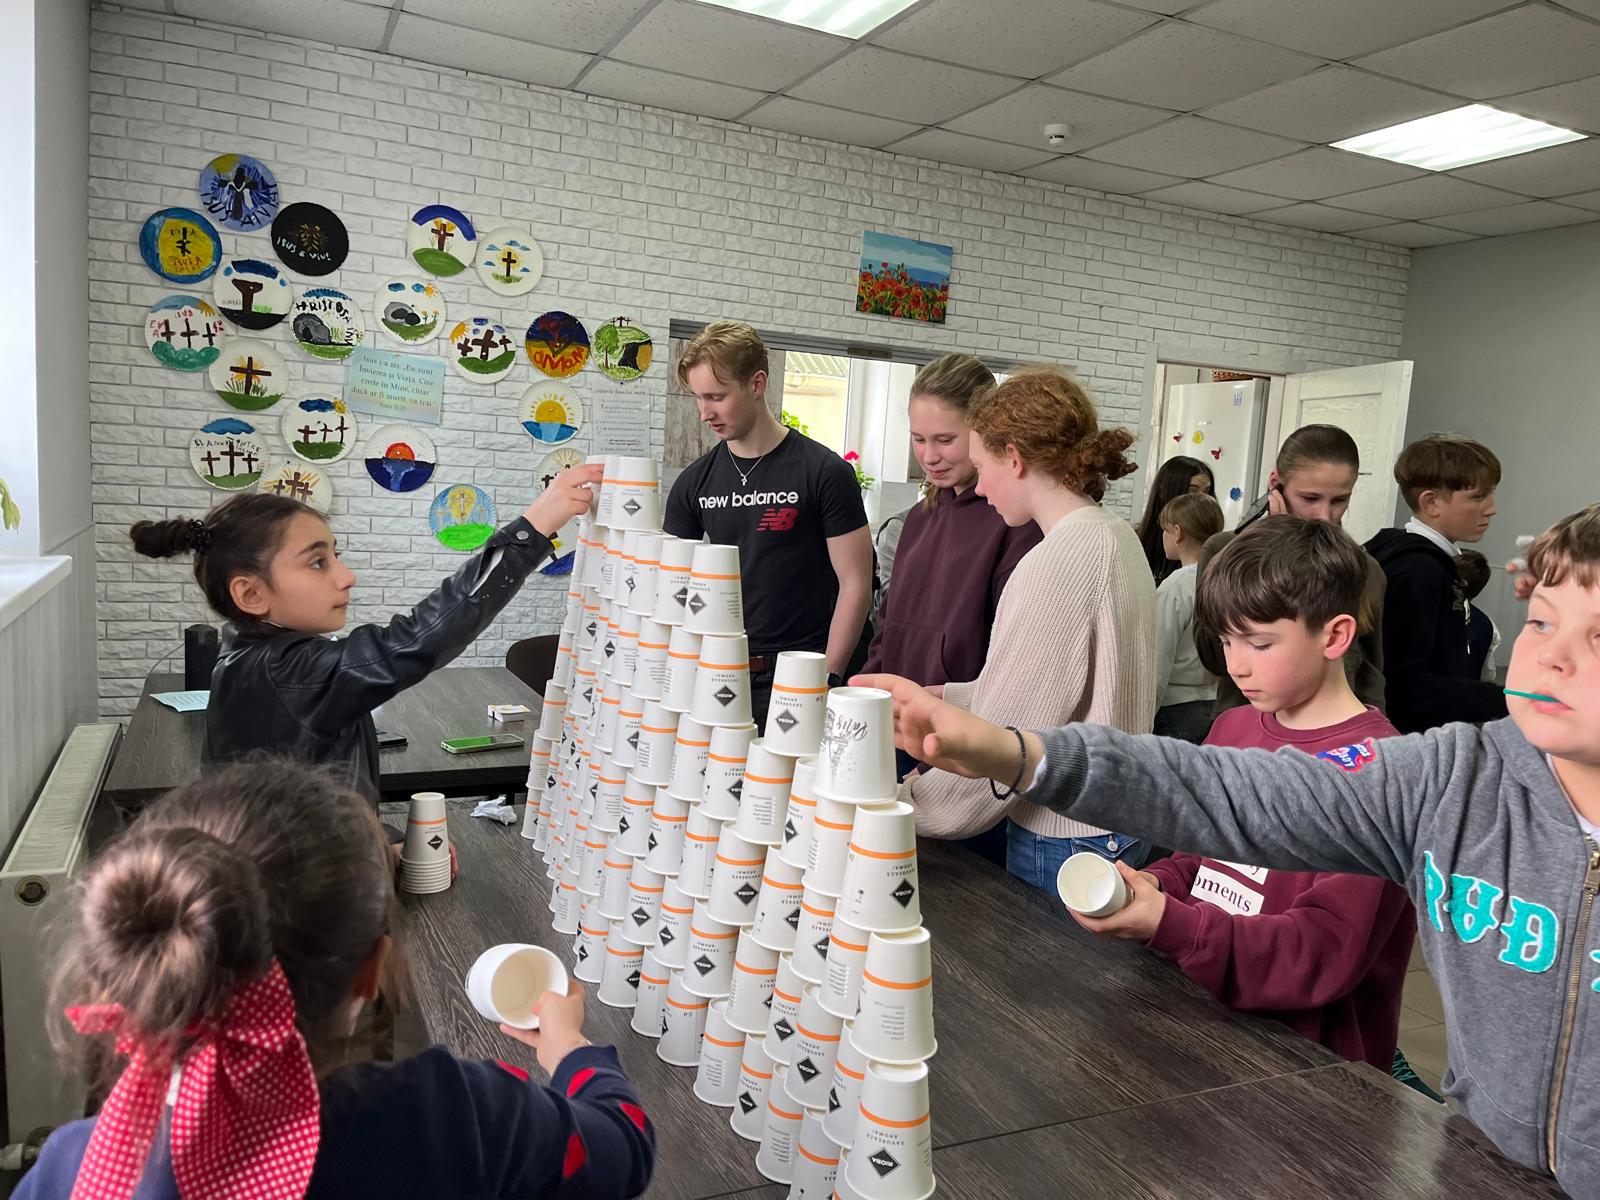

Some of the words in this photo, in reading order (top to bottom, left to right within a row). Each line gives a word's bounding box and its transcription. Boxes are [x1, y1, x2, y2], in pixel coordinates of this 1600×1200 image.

[698, 494, 729, 510] new
[731, 489, 799, 507] balance
[871, 1156, 894, 1168] RIOBA
